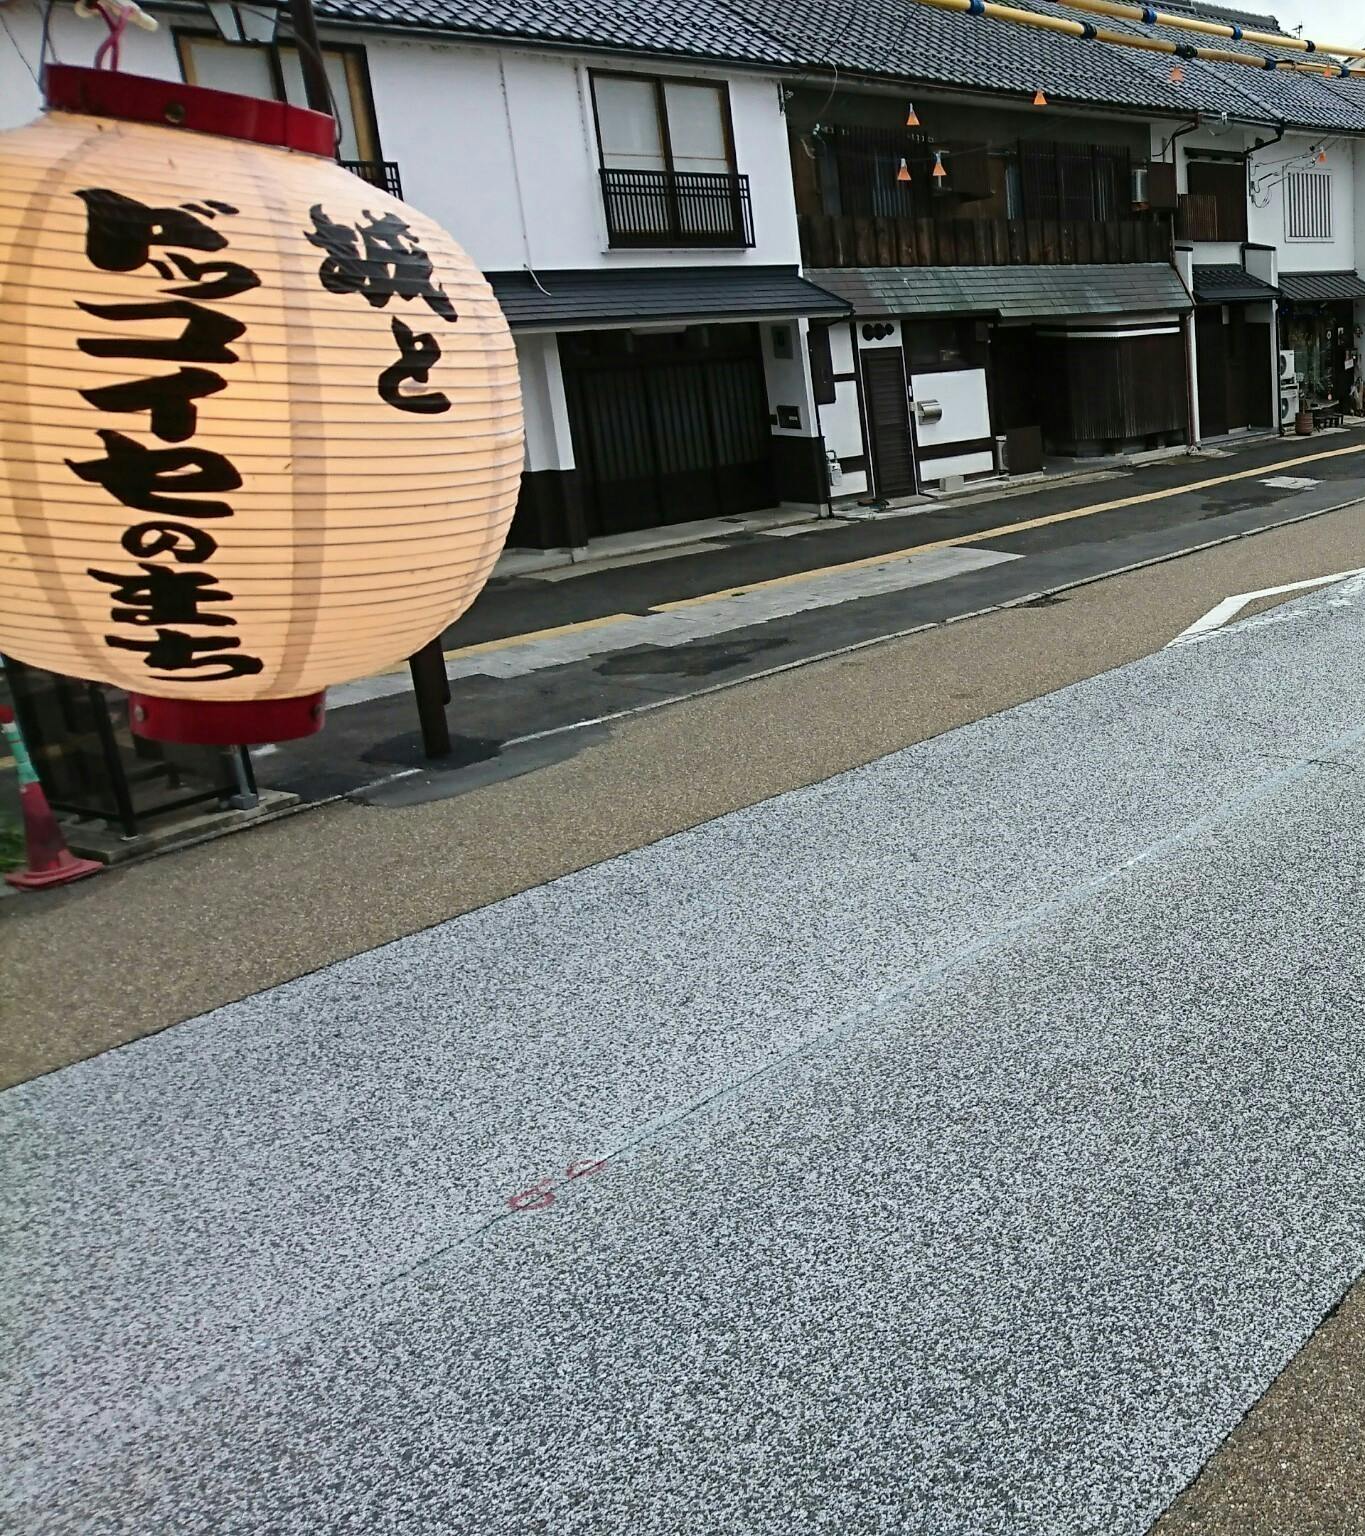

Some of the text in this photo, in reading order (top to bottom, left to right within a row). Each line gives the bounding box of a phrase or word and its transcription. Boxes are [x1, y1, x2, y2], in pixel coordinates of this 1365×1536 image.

[63, 187, 265, 683] ドッコイセのまち
